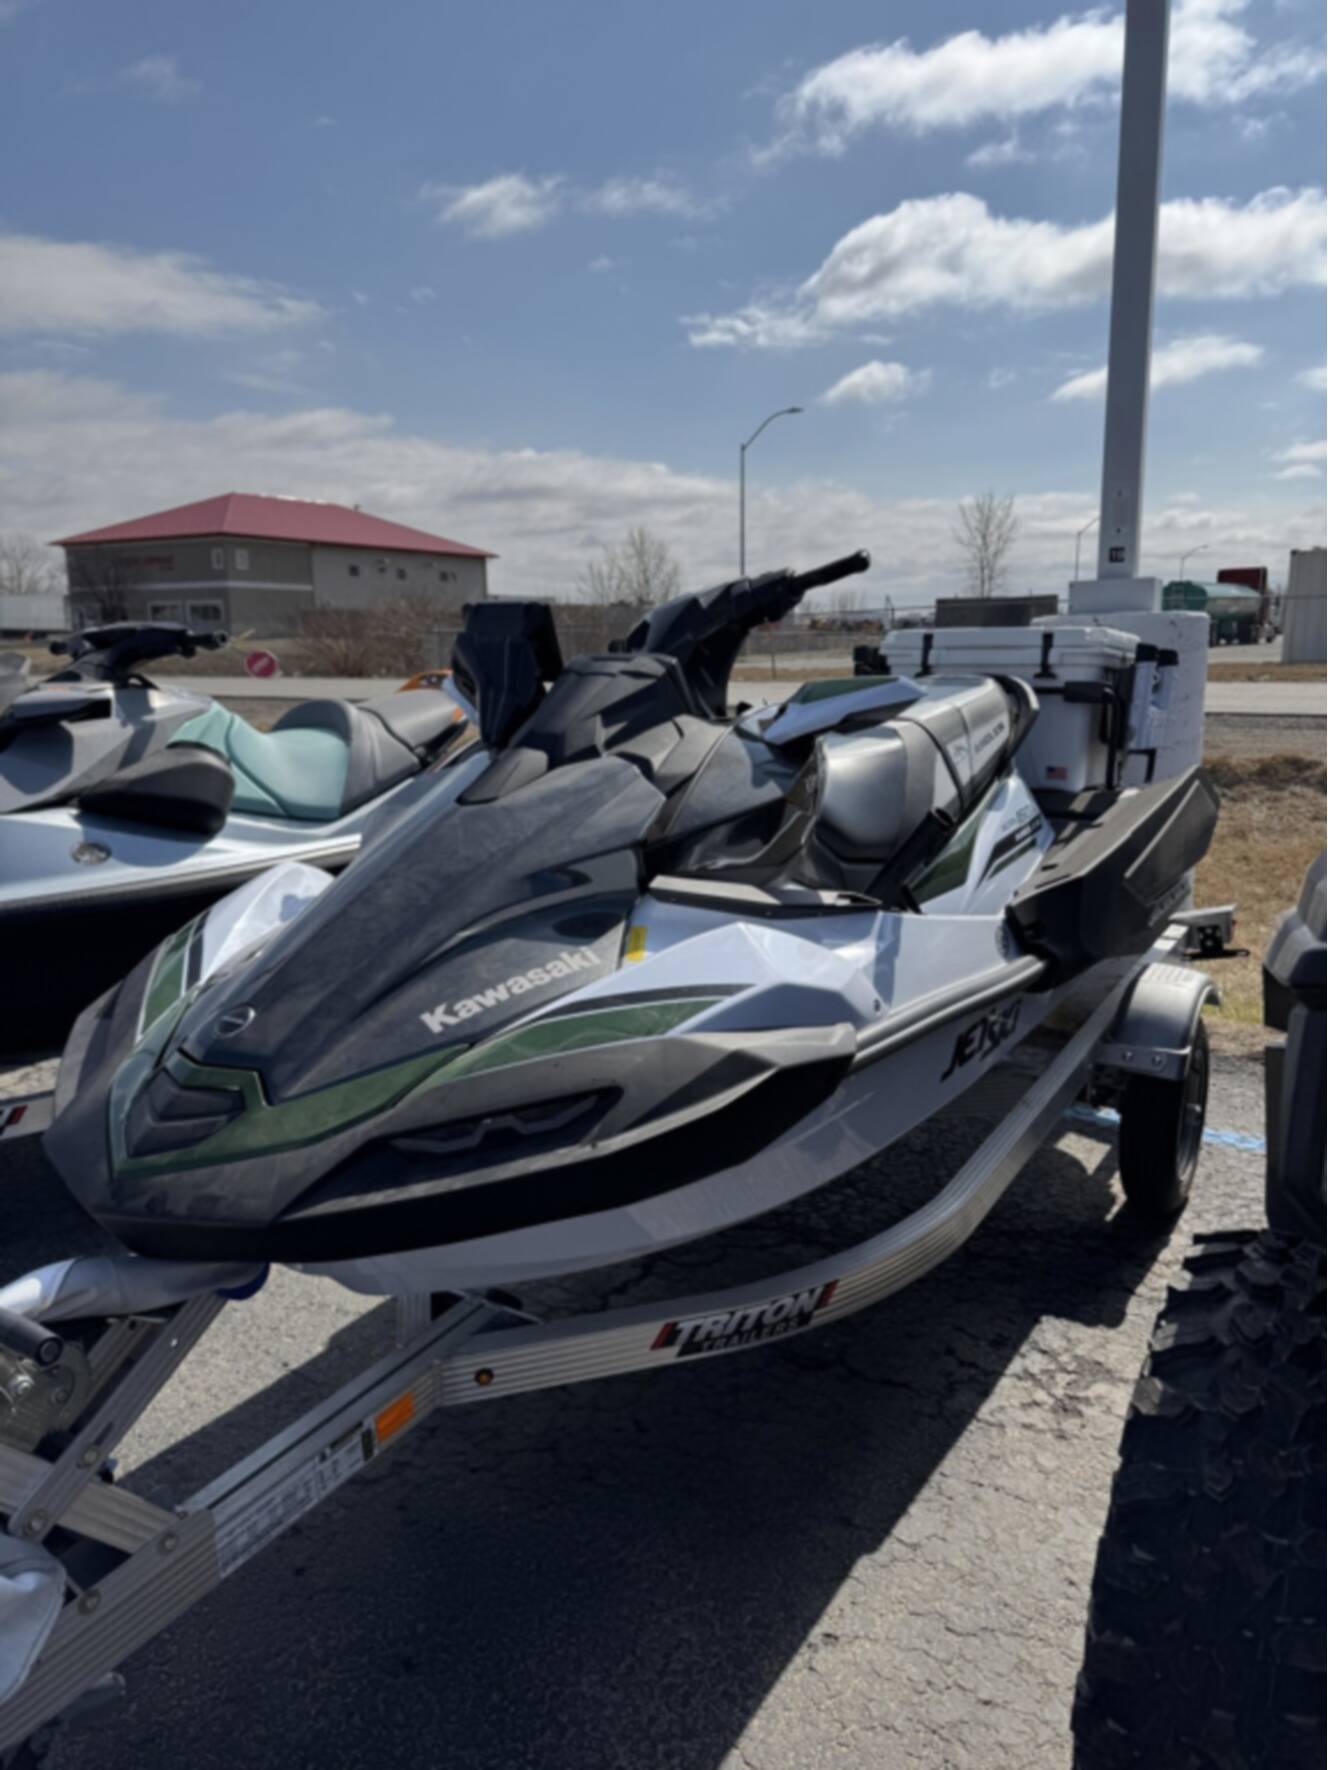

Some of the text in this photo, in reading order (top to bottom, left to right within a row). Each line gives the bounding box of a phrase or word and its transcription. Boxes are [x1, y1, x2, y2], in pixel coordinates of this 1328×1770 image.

[419, 946, 601, 1035] Kawasaki
[674, 1285, 822, 1346] TRITON
[703, 1319, 799, 1351] TRAILERS
